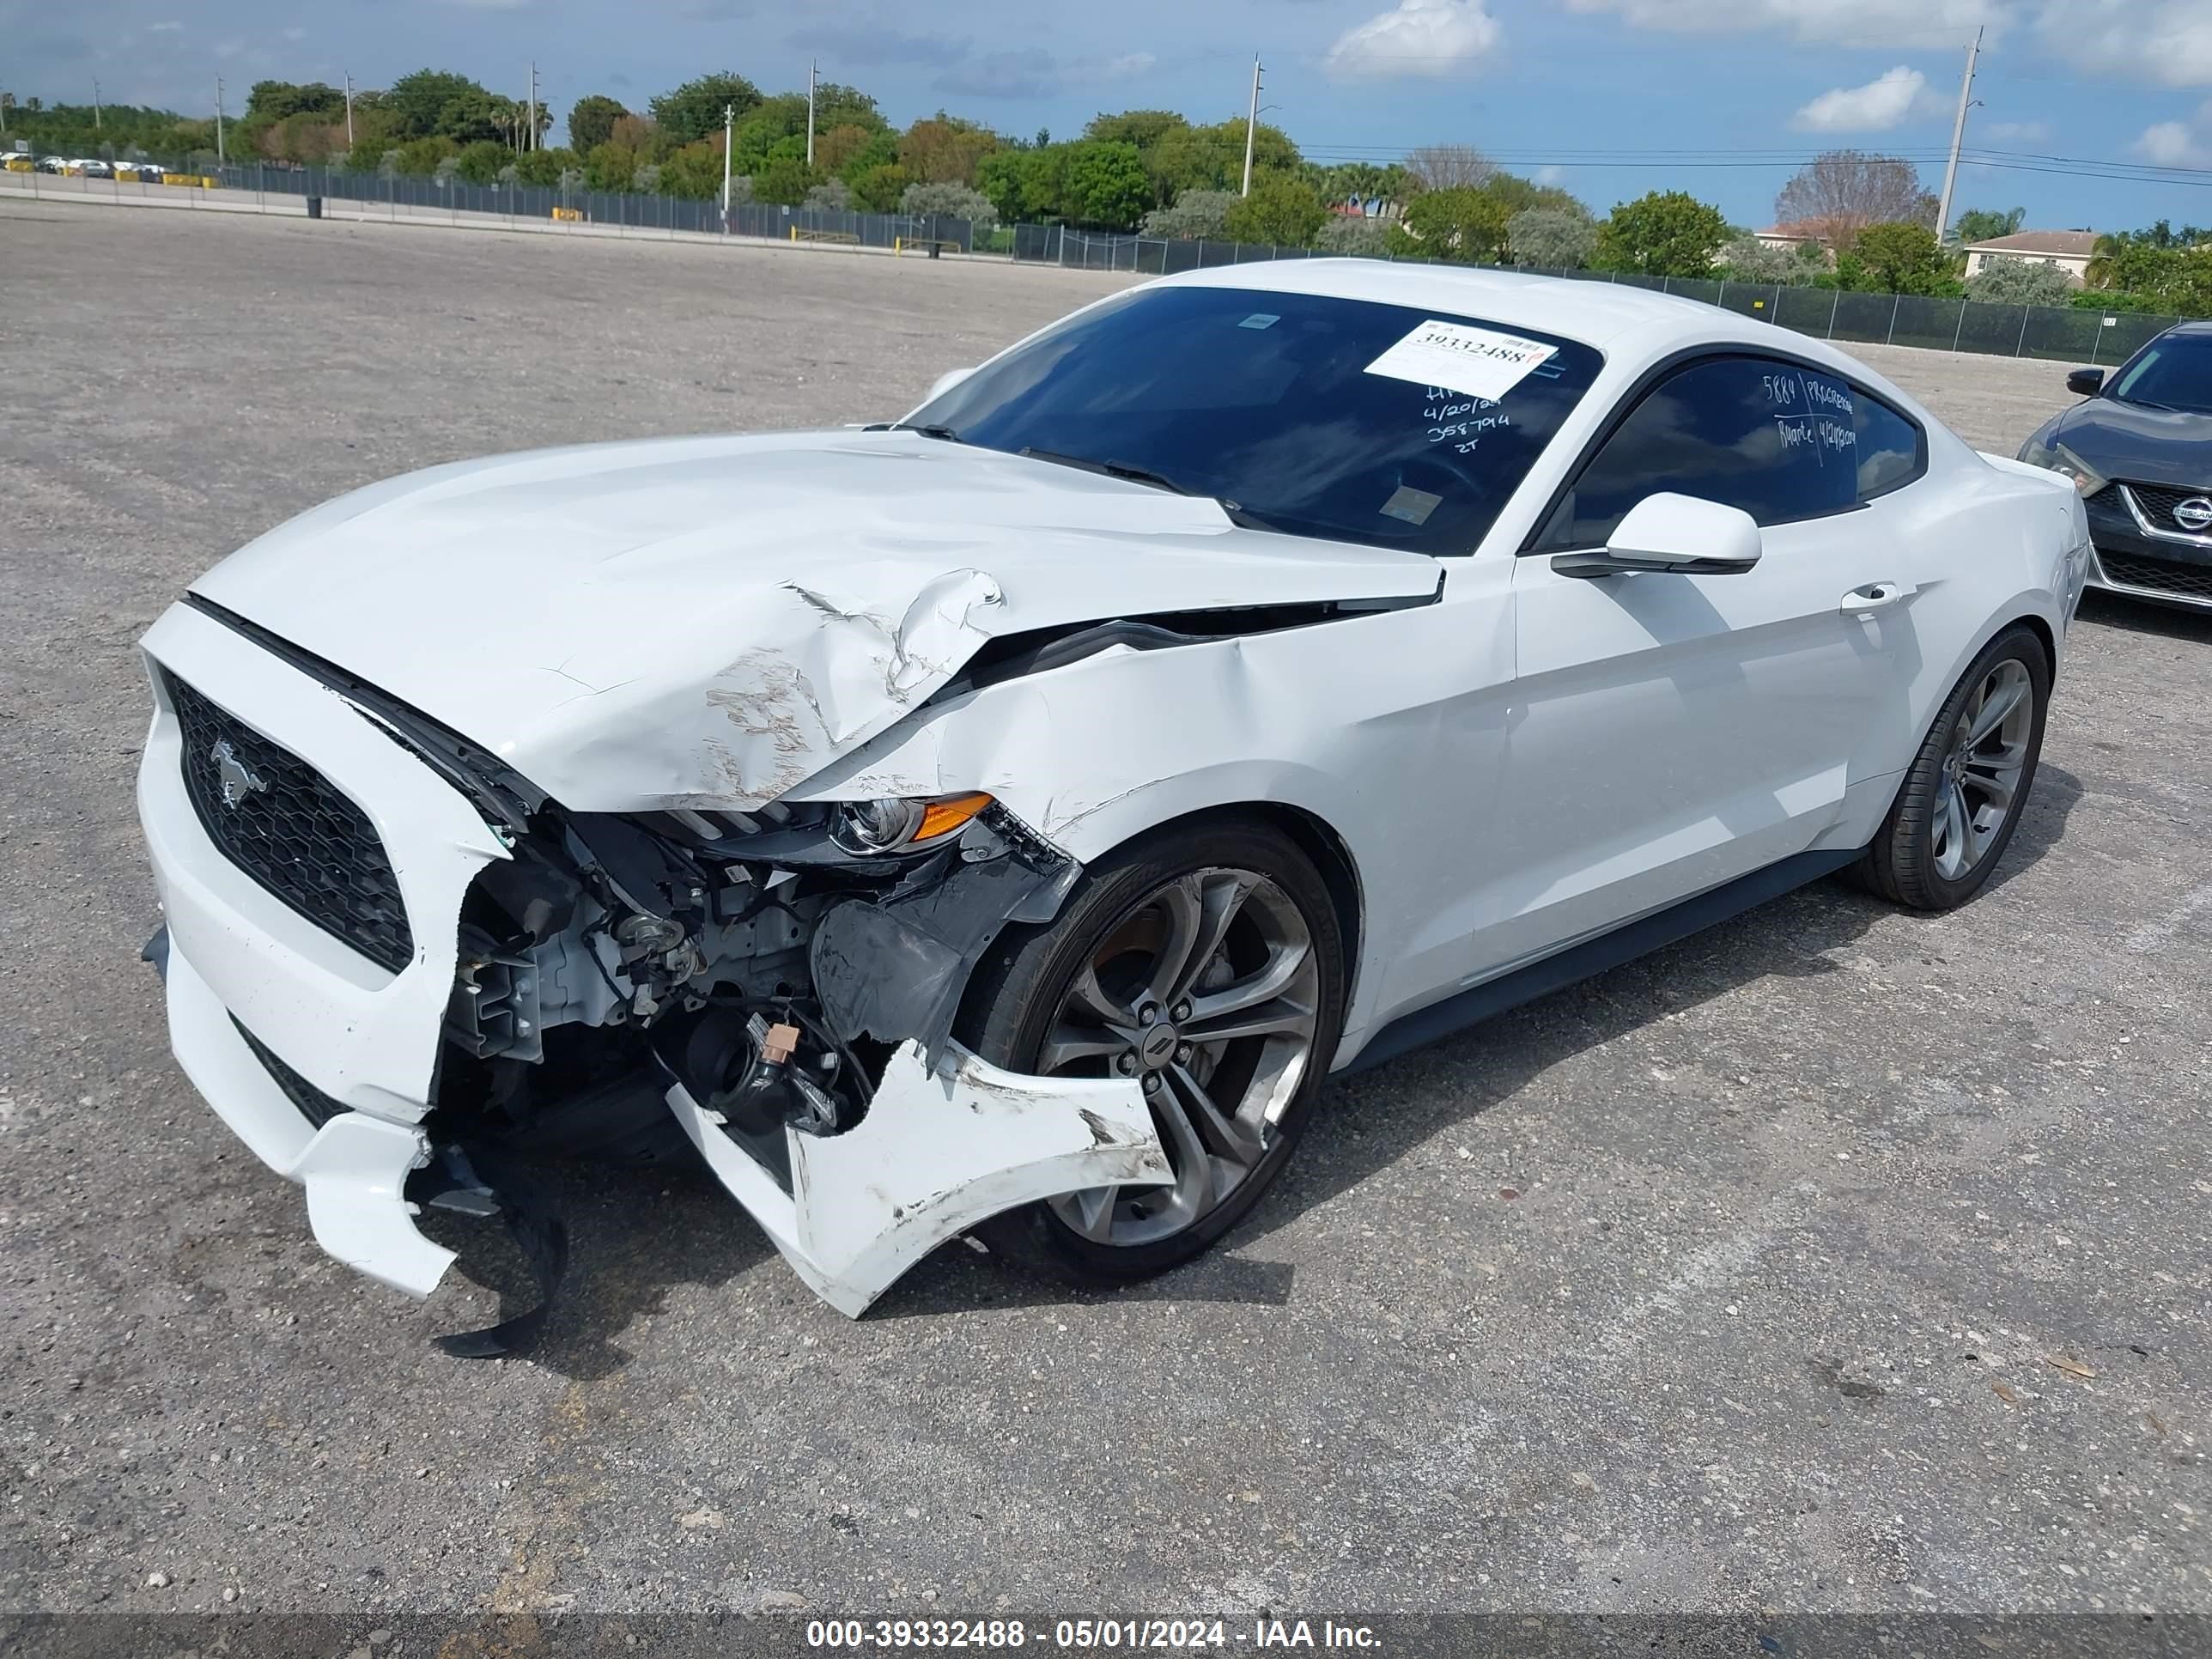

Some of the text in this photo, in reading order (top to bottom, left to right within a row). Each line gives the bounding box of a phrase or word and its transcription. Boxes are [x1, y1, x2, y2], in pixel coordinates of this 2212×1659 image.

[1416, 333, 1526, 363] 39332488
[1763, 375, 1796, 404] 5884
[1427, 415, 1510, 442] 358794
